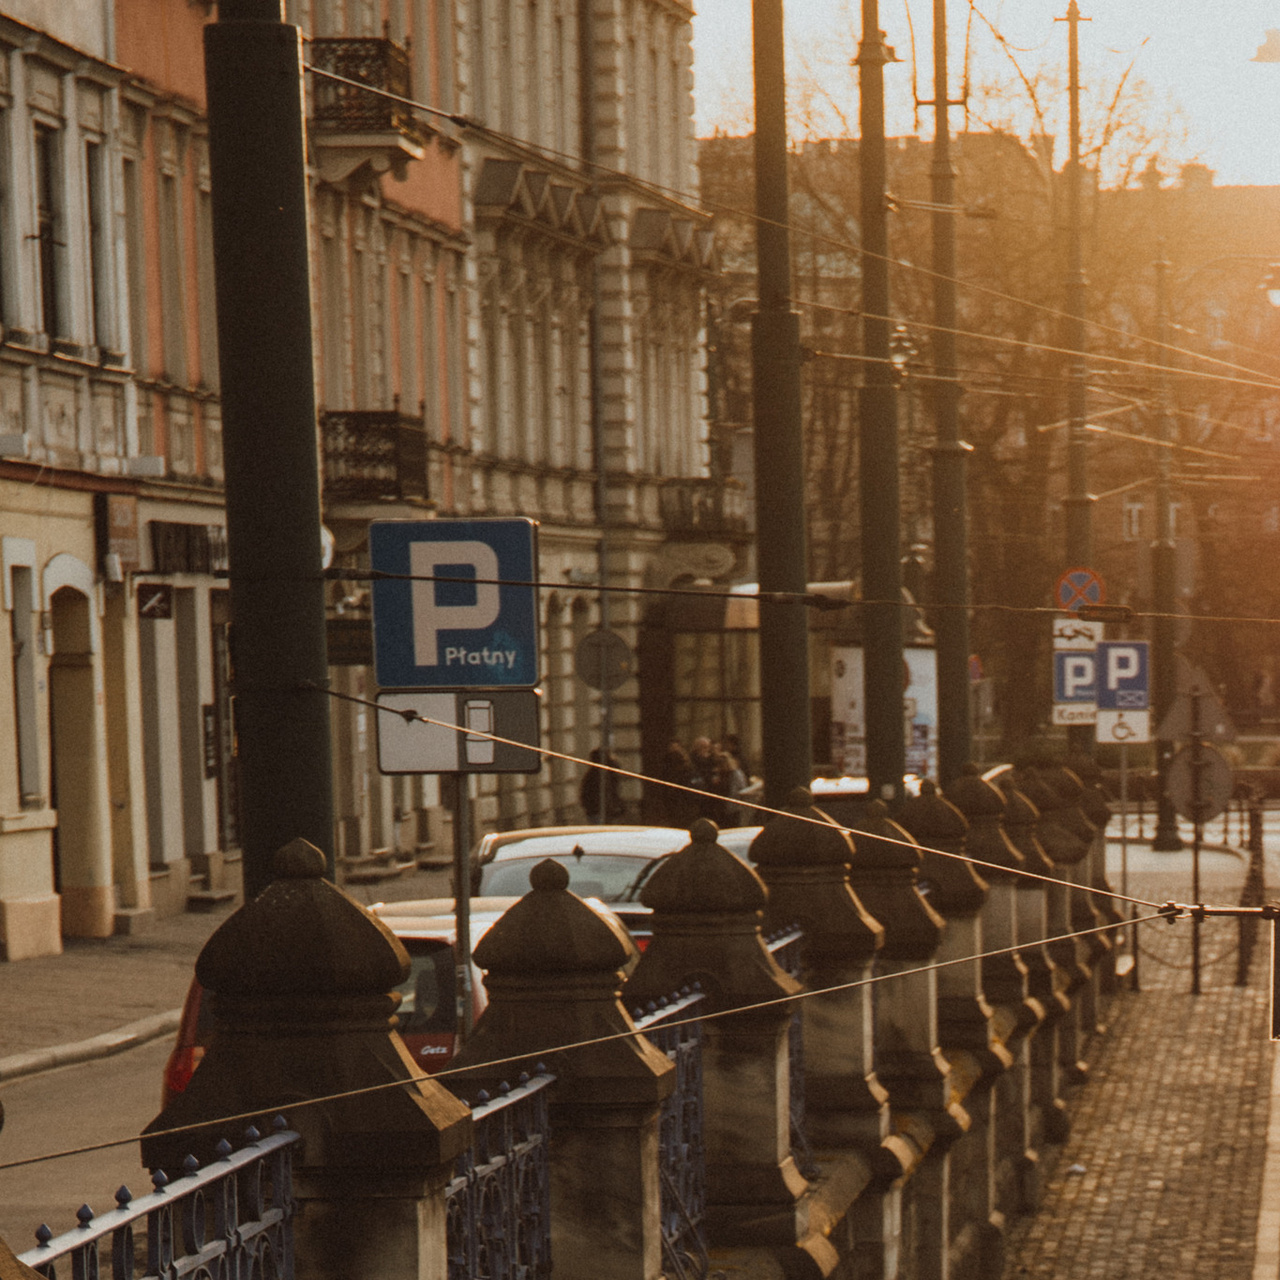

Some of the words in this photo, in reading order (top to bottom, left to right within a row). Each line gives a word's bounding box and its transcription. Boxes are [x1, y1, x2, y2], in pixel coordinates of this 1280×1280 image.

[409, 540, 500, 667] P
[445, 646, 517, 669] Płatny
[1064, 656, 1095, 698] P
[1107, 647, 1139, 690] P
[421, 1045, 448, 1055] Getz
